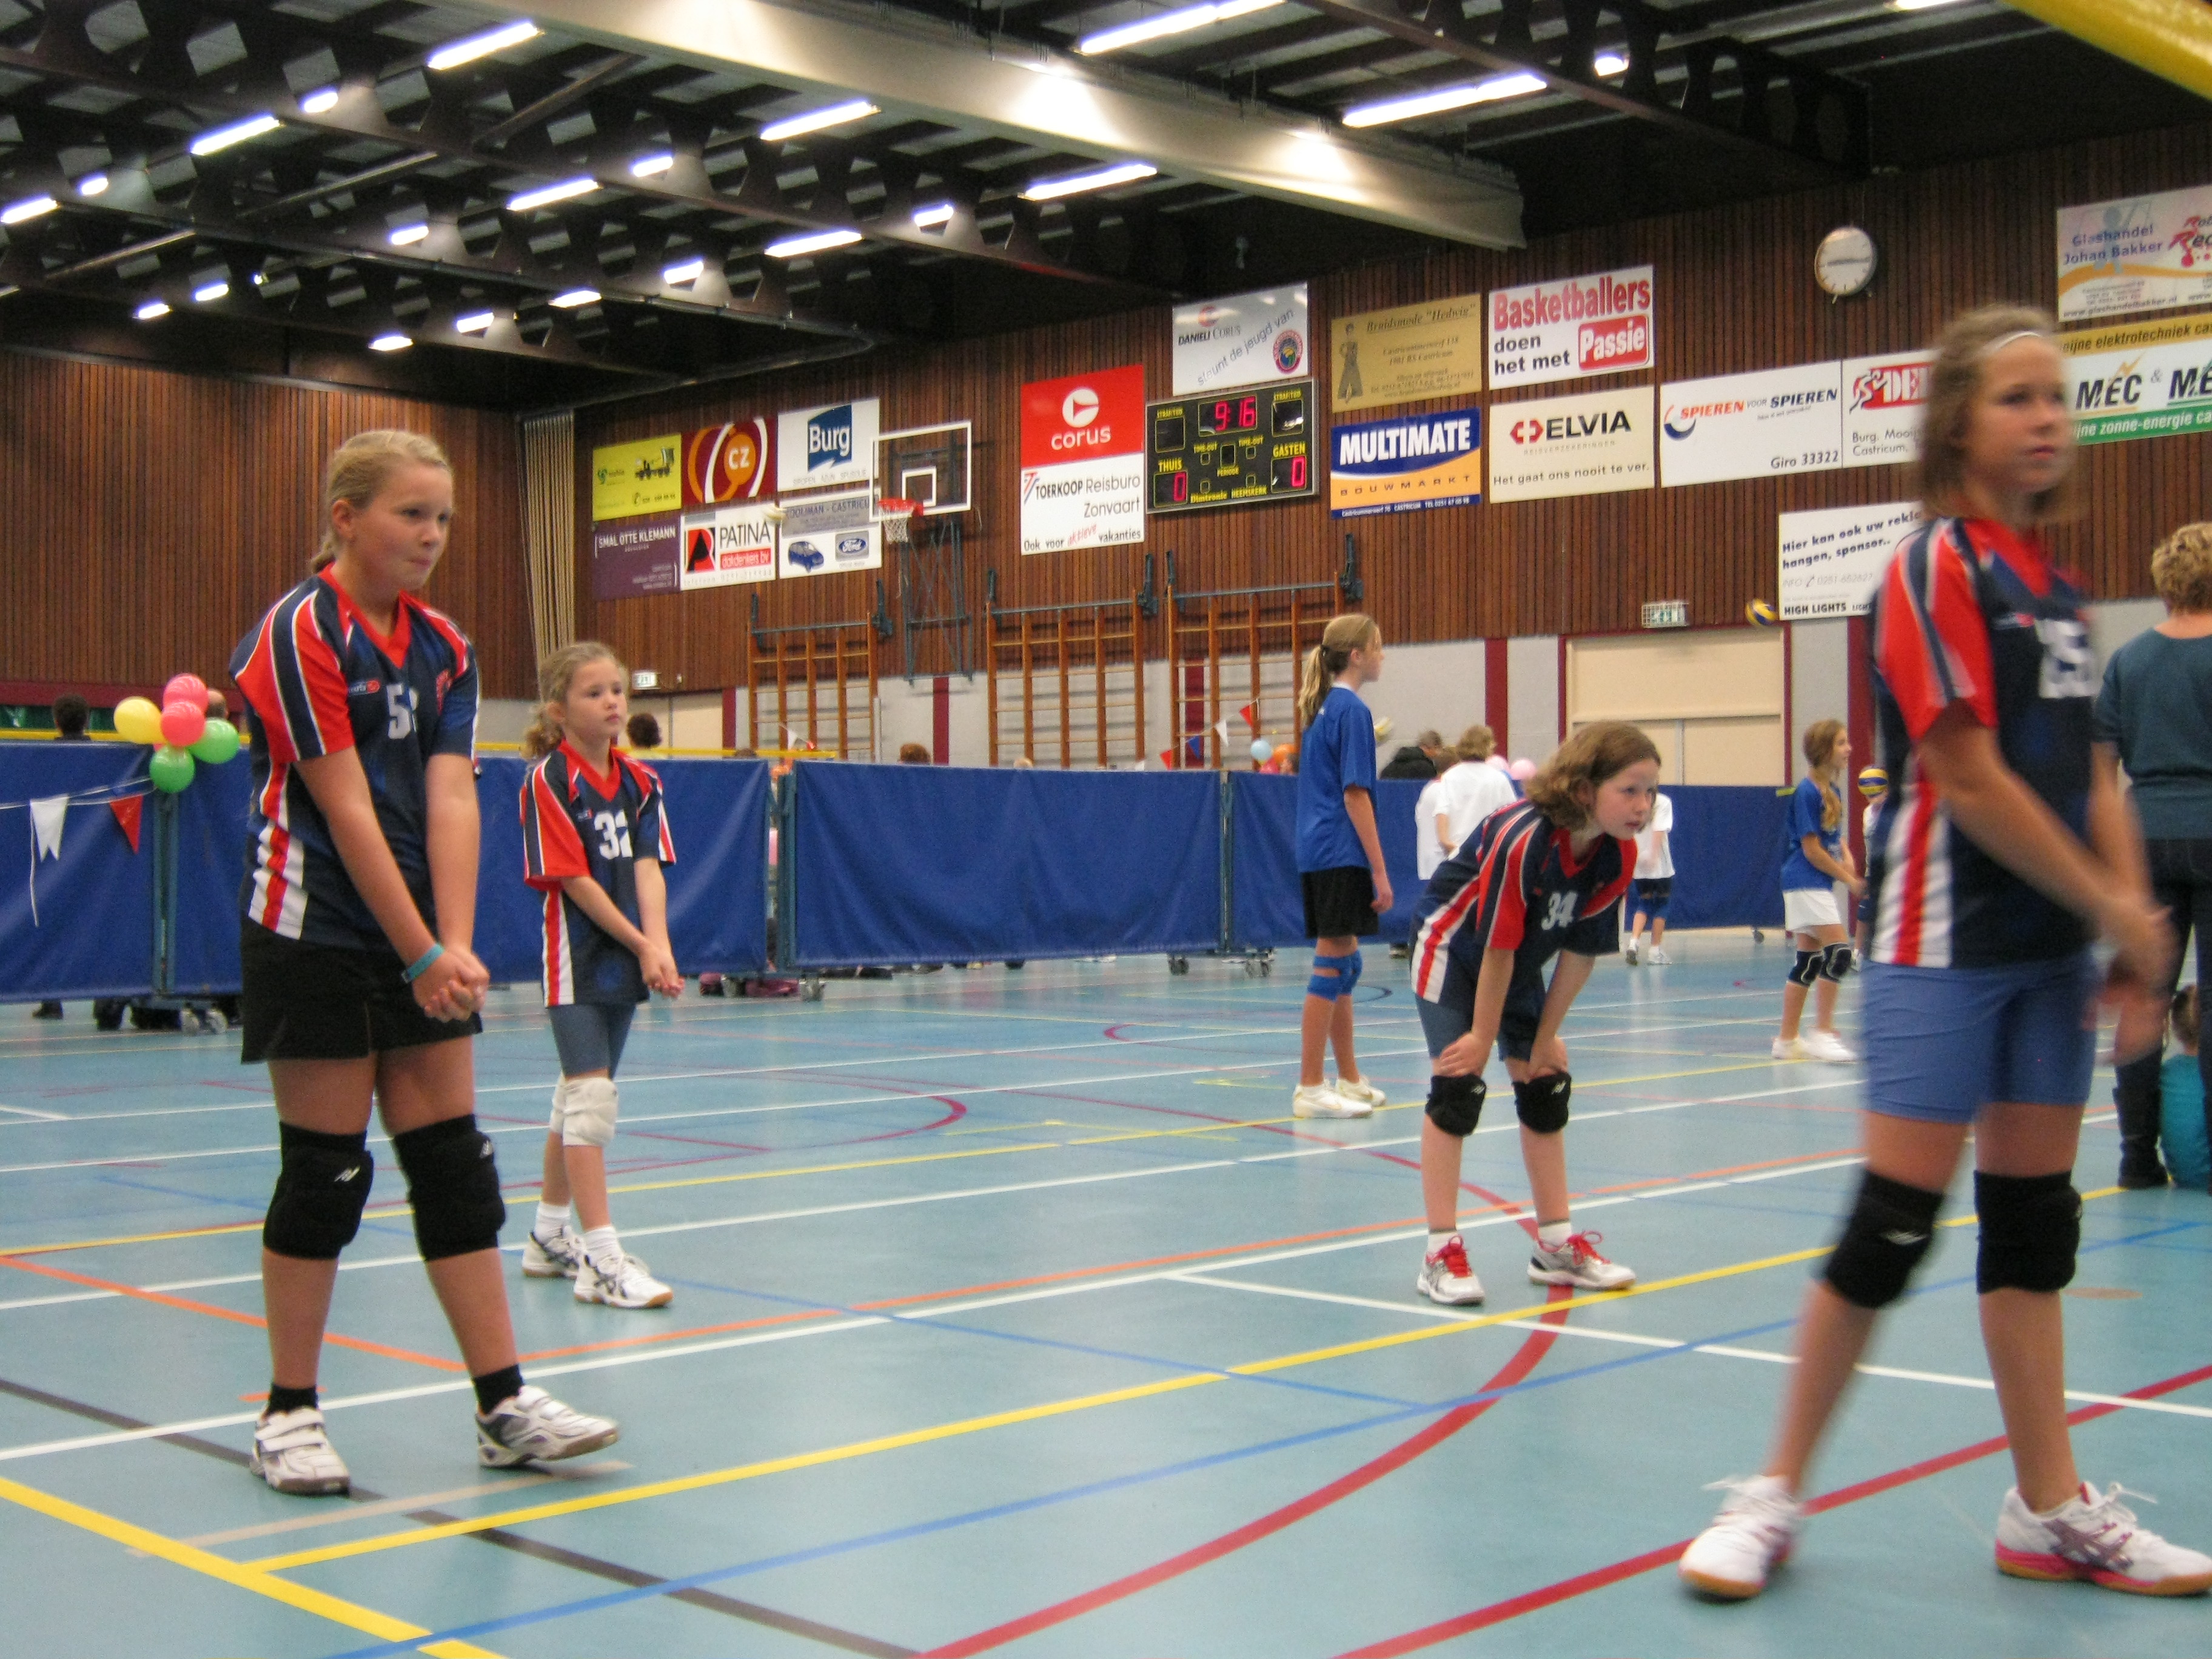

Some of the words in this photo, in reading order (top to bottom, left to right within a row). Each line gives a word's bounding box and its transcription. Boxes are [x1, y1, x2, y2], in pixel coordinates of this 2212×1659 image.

[2072, 224, 2153, 247] Glashandel
[2065, 250, 2106, 266] Johan
[2111, 242, 2162, 258] Bakker
[1493, 275, 1651, 332] Basketballers
[1178, 330, 1210, 346] DANIELI
[1197, 357, 1228, 386] steunt
[1229, 345, 1243, 362] de
[1244, 322, 1273, 355] jeugd
[1275, 309, 1295, 328] van
[1493, 335, 1541, 354] doen
[1580, 319, 1645, 363] Passie
[2096, 323, 2190, 349] elektrotechniek
[1494, 355, 1526, 376] het
[1532, 349, 1570, 370] met
[2076, 374, 2142, 411] MEC
[2151, 367, 2162, 383] &
[1680, 399, 1745, 420] SPIEREN
[1747, 397, 1768, 409] VOOR
[1770, 388, 1838, 409] SPIEREN
[1546, 409, 1632, 441] ELVIA
[2100, 411, 2192, 434] zonne-energie
[809, 425, 851, 458] Burg
[1051, 426, 1111, 451] corus
[1273, 443, 1306, 457] GASTEN
[1339, 417, 1471, 466] MULTIMATE
[1852, 431, 1879, 444] Burg.
[1852, 443, 1908, 457] Castricum.
[728, 447, 751, 471] CZ
[1158, 458, 1182, 472] THUIS
[1291, 455, 1306, 488] 0
[1771, 456, 1797, 469] Giro
[1801, 450, 1838, 466] 33322
[1036, 479, 1083, 500] TOERKOOP
[1085, 474, 1141, 494] Reisburo
[1173, 471, 1187, 502] 0
[1340, 474, 1470, 497] BOUWMARKT
[1493, 475, 1513, 486] Het
[1518, 472, 1544, 486] gaat
[1548, 471, 1570, 481] ons
[1575, 465, 1606, 478] nooit
[1611, 464, 1623, 474] te
[1627, 463, 1649, 473] ver.
[1084, 496, 1140, 518] Zonvaart
[598, 534, 618, 549] SMAL
[619, 531, 637, 546] OTTE
[638, 525, 677, 543] KLEMANN
[719, 520, 772, 549] PATINA
[1024, 538, 1041, 552] Ook
[1045, 539, 1064, 549] voor
[1098, 527, 1141, 544] vakanties
[1782, 540, 1808, 554] Hier
[1812, 534, 1835, 546] kan
[1839, 525, 1862, 538] ook
[1866, 521, 1883, 533] uw
[1782, 552, 1832, 569] hangen,
[1835, 538, 1891, 557] sponsor..
[1784, 605, 1808, 616] HIGH
[1812, 602, 1846, 614] LIGHTS
[1541, 890, 1578, 931] 34
